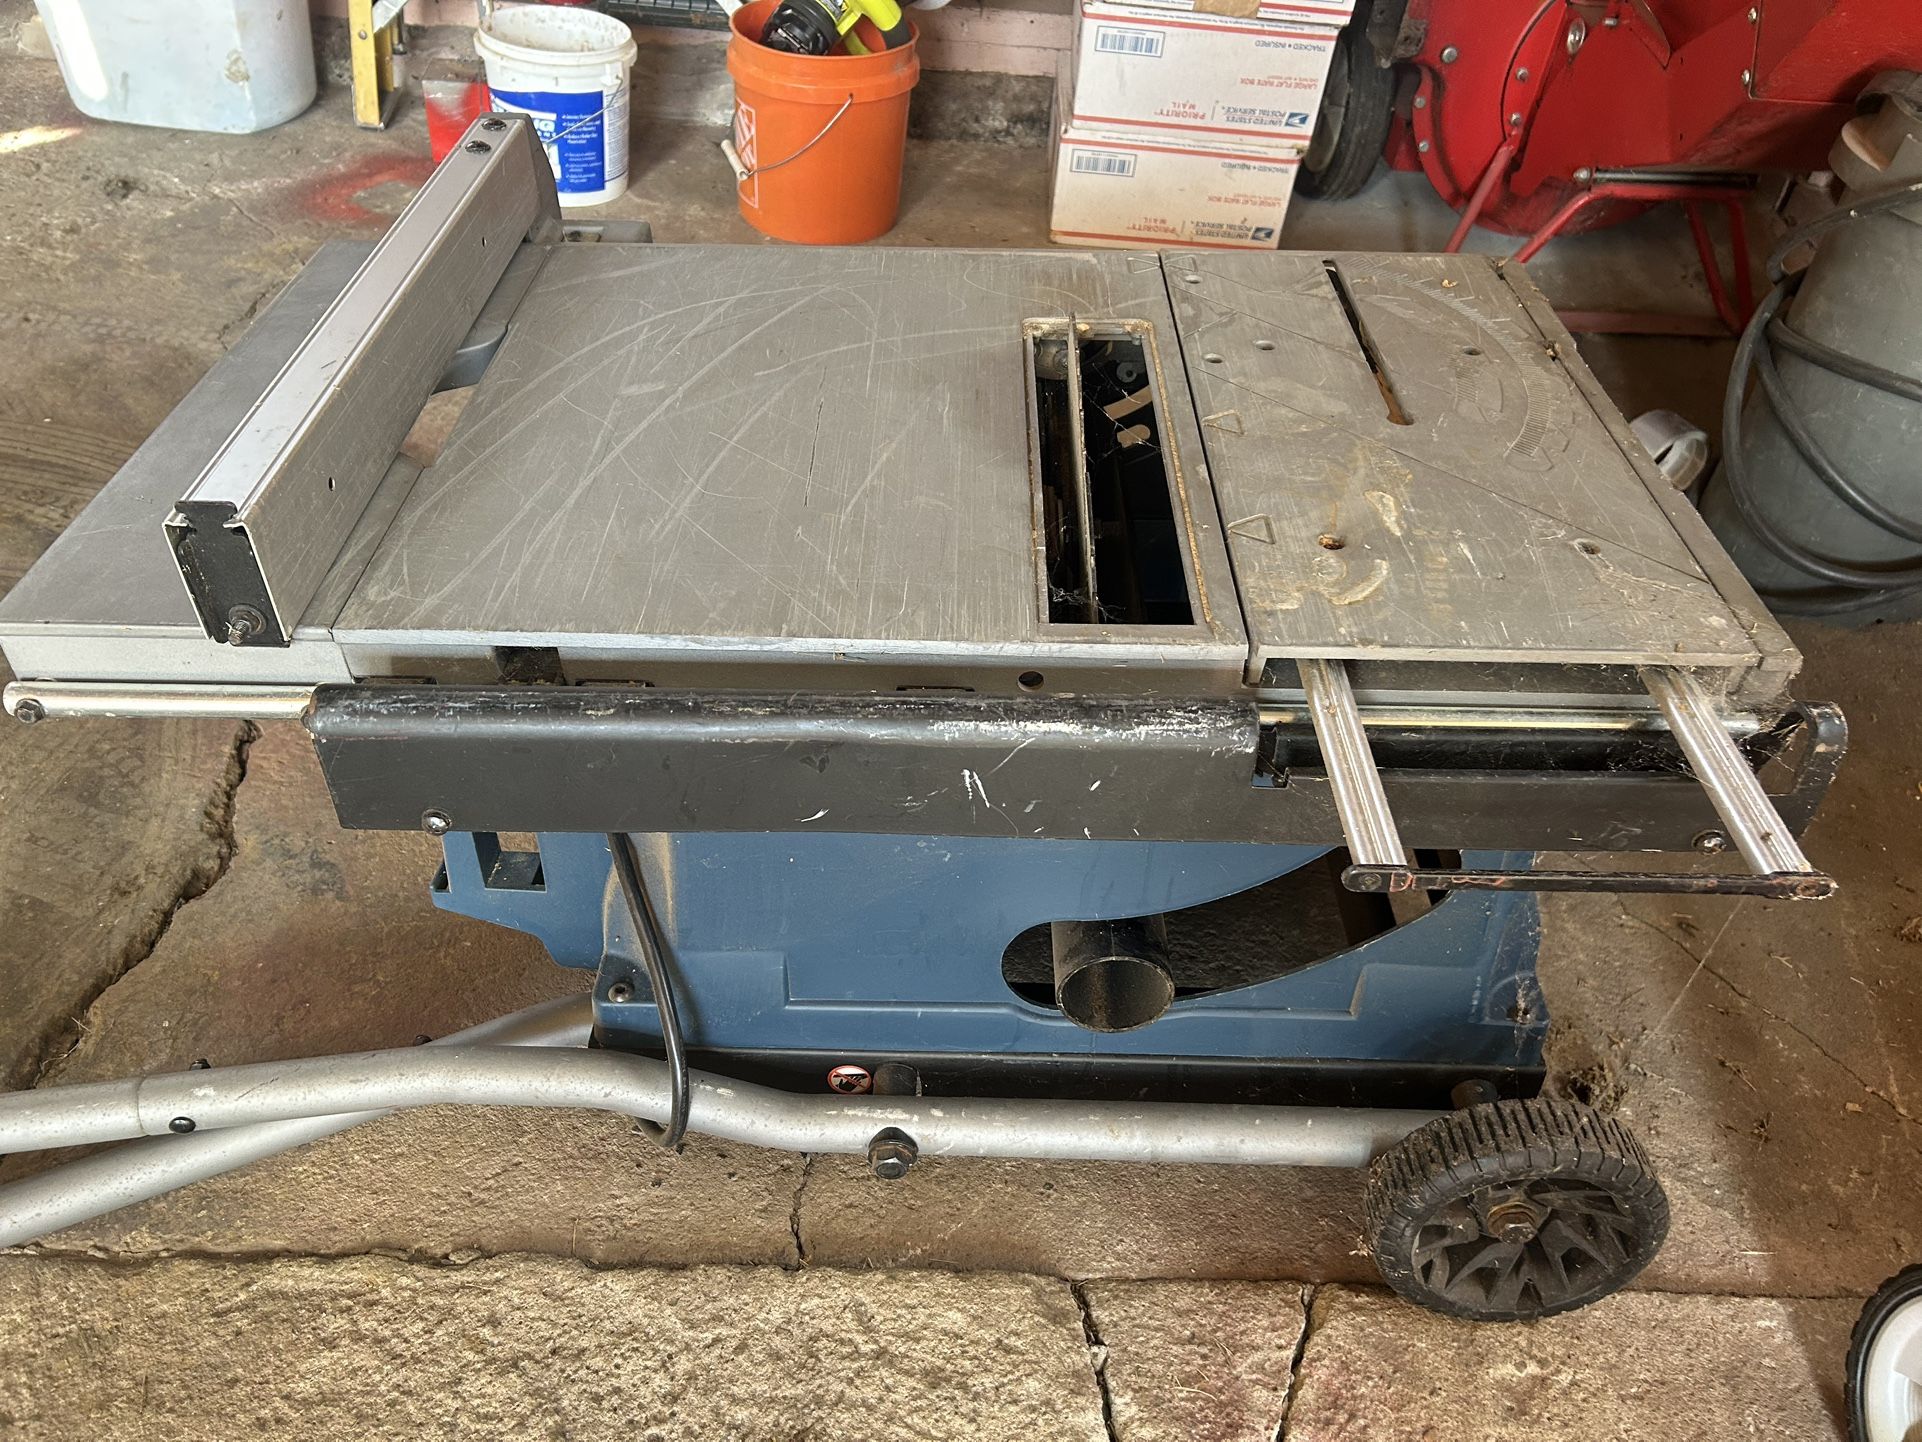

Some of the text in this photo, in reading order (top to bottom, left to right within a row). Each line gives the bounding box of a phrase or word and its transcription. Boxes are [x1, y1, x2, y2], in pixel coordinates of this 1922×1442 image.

[1255, 39, 1326, 52] TRACKED INSURED
[1240, 77, 1255, 86] BOX
[1257, 78, 1274, 87] RATE
[1275, 80, 1293, 88] FLAT
[1294, 82, 1318, 91] LARGE
[1171, 101, 1196, 110] MAIL
[1158, 108, 1207, 121] PRIORITY
[1258, 108, 1286, 117] POSTAL
[1225, 114, 1283, 128] UNITED STATES
[1143, 217, 1168, 225] MAIL
[1129, 223, 1177, 234] PRIORITY
